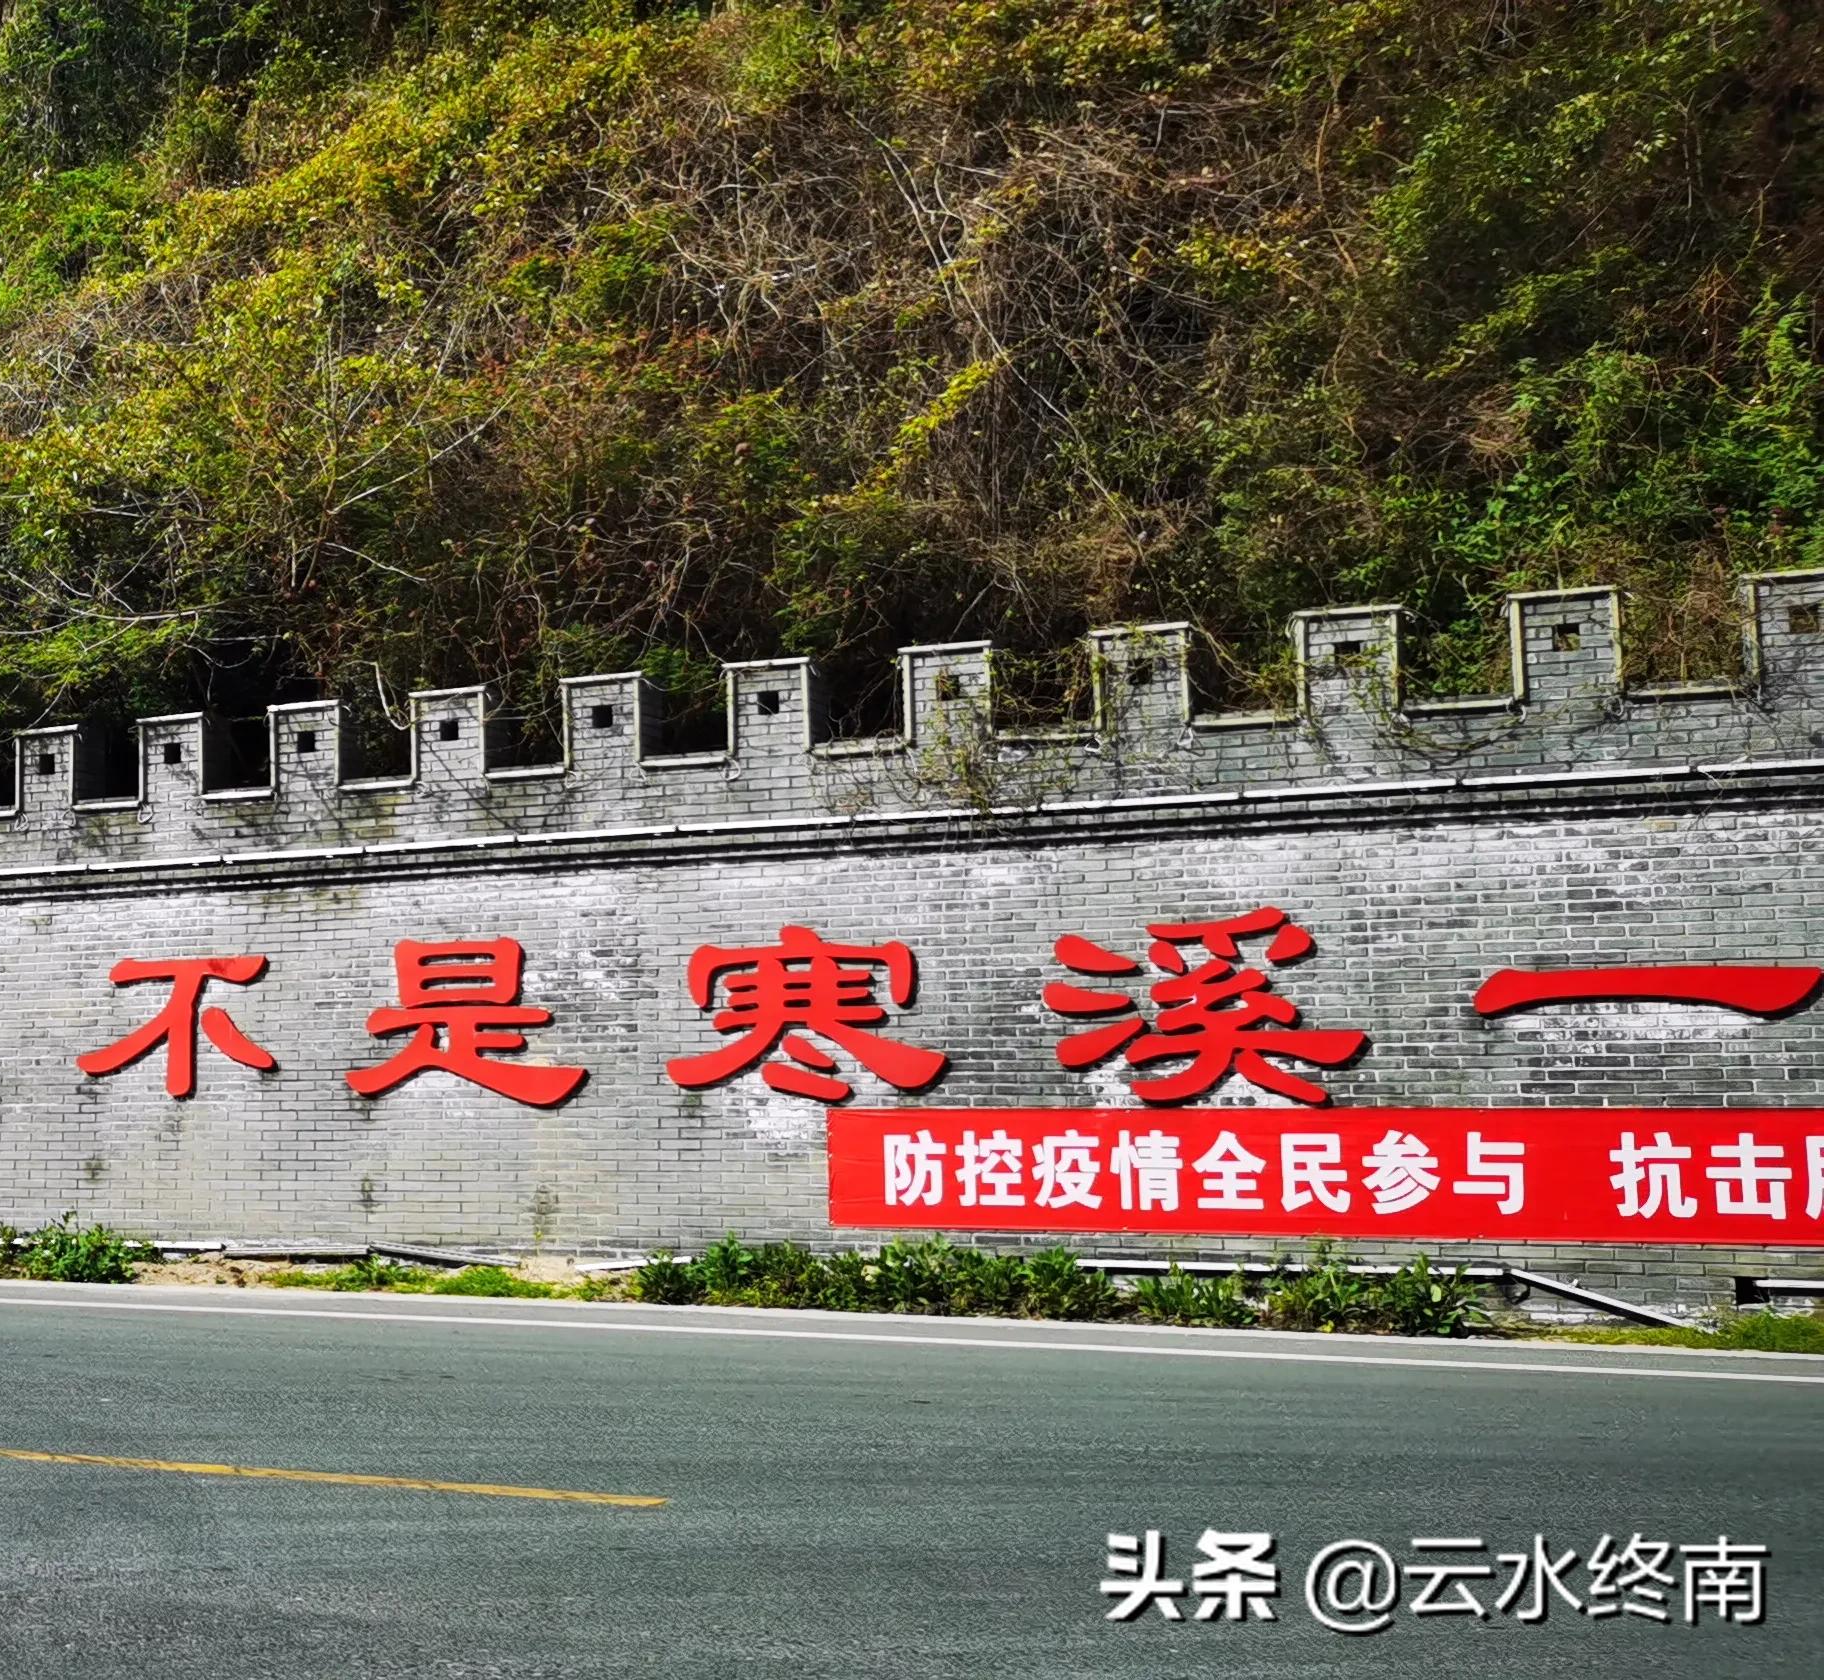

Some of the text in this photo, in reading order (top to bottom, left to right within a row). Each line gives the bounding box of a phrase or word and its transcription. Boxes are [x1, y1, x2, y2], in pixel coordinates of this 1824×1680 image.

[883, 1129, 1525, 1216] 防控疫情全民参与
